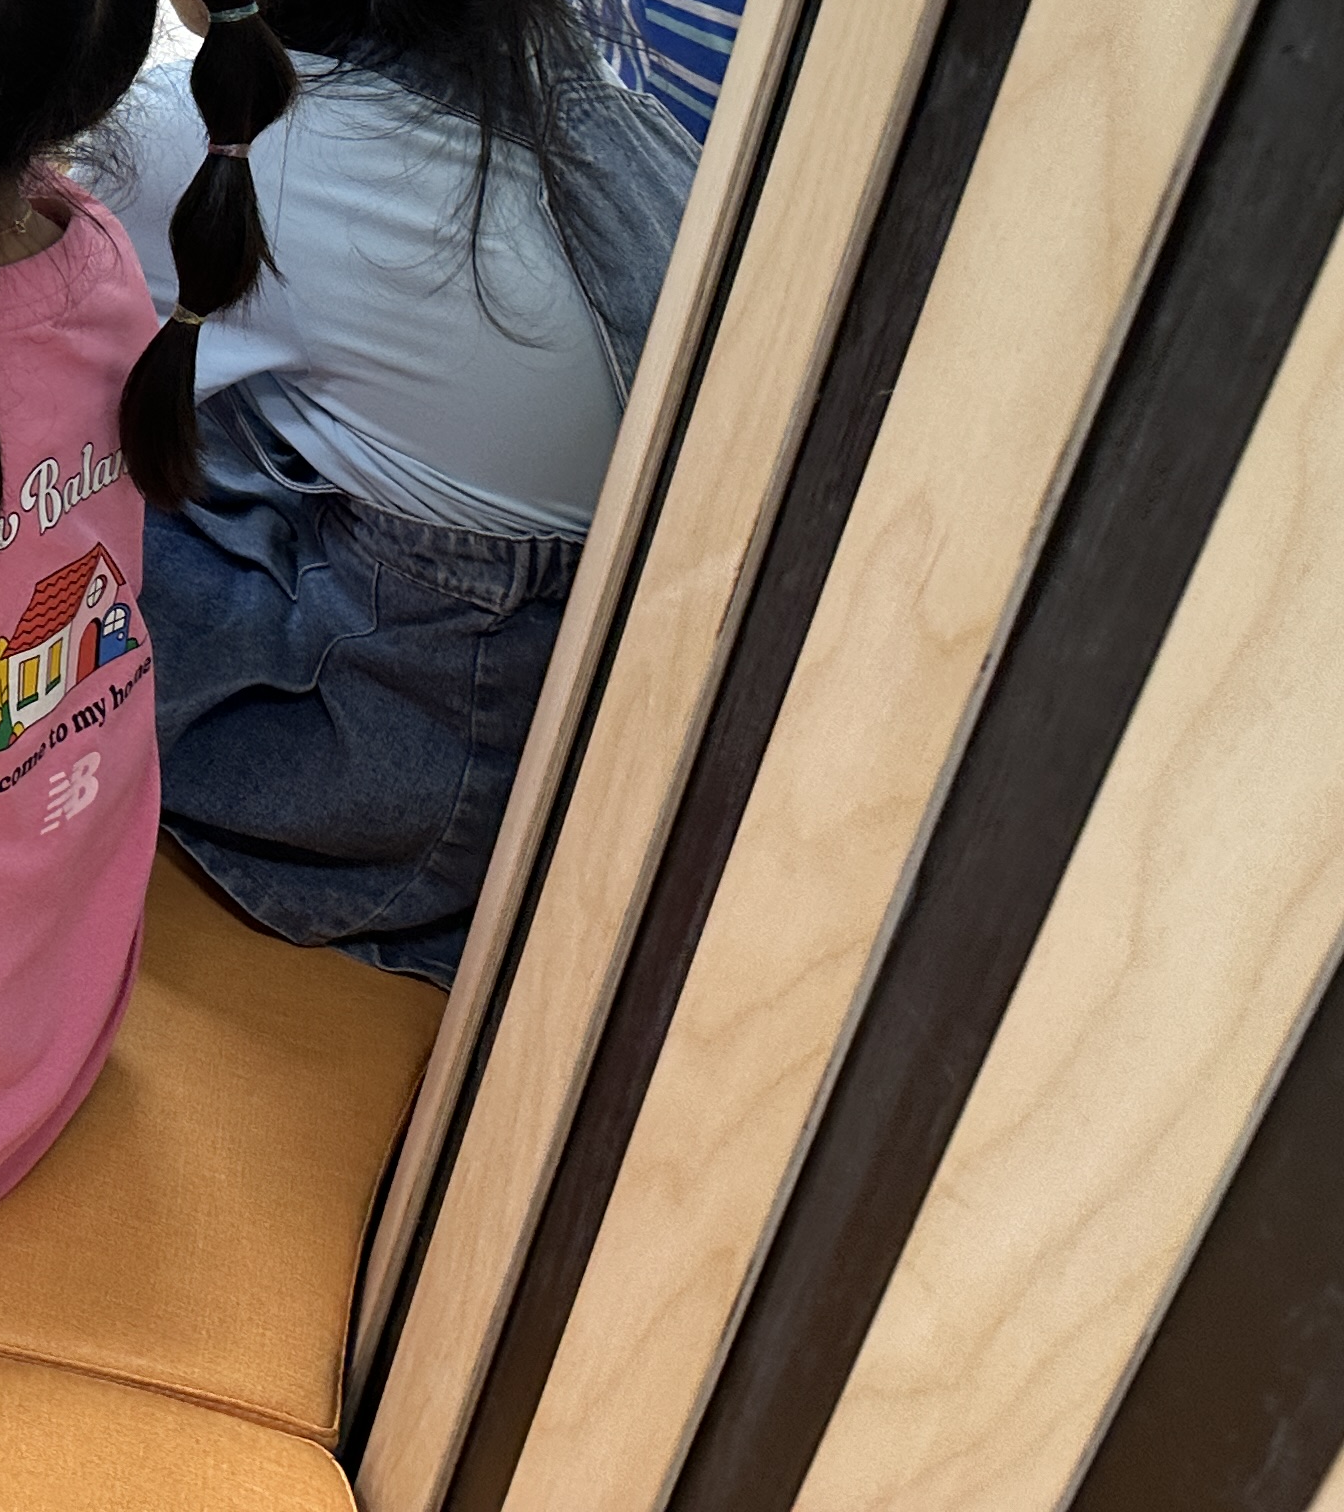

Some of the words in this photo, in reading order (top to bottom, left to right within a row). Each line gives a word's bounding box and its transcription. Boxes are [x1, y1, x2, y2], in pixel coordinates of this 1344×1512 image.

[20, 441, 128, 536] Balan
[49, 722, 68, 749] to
[72, 698, 105, 727] my
